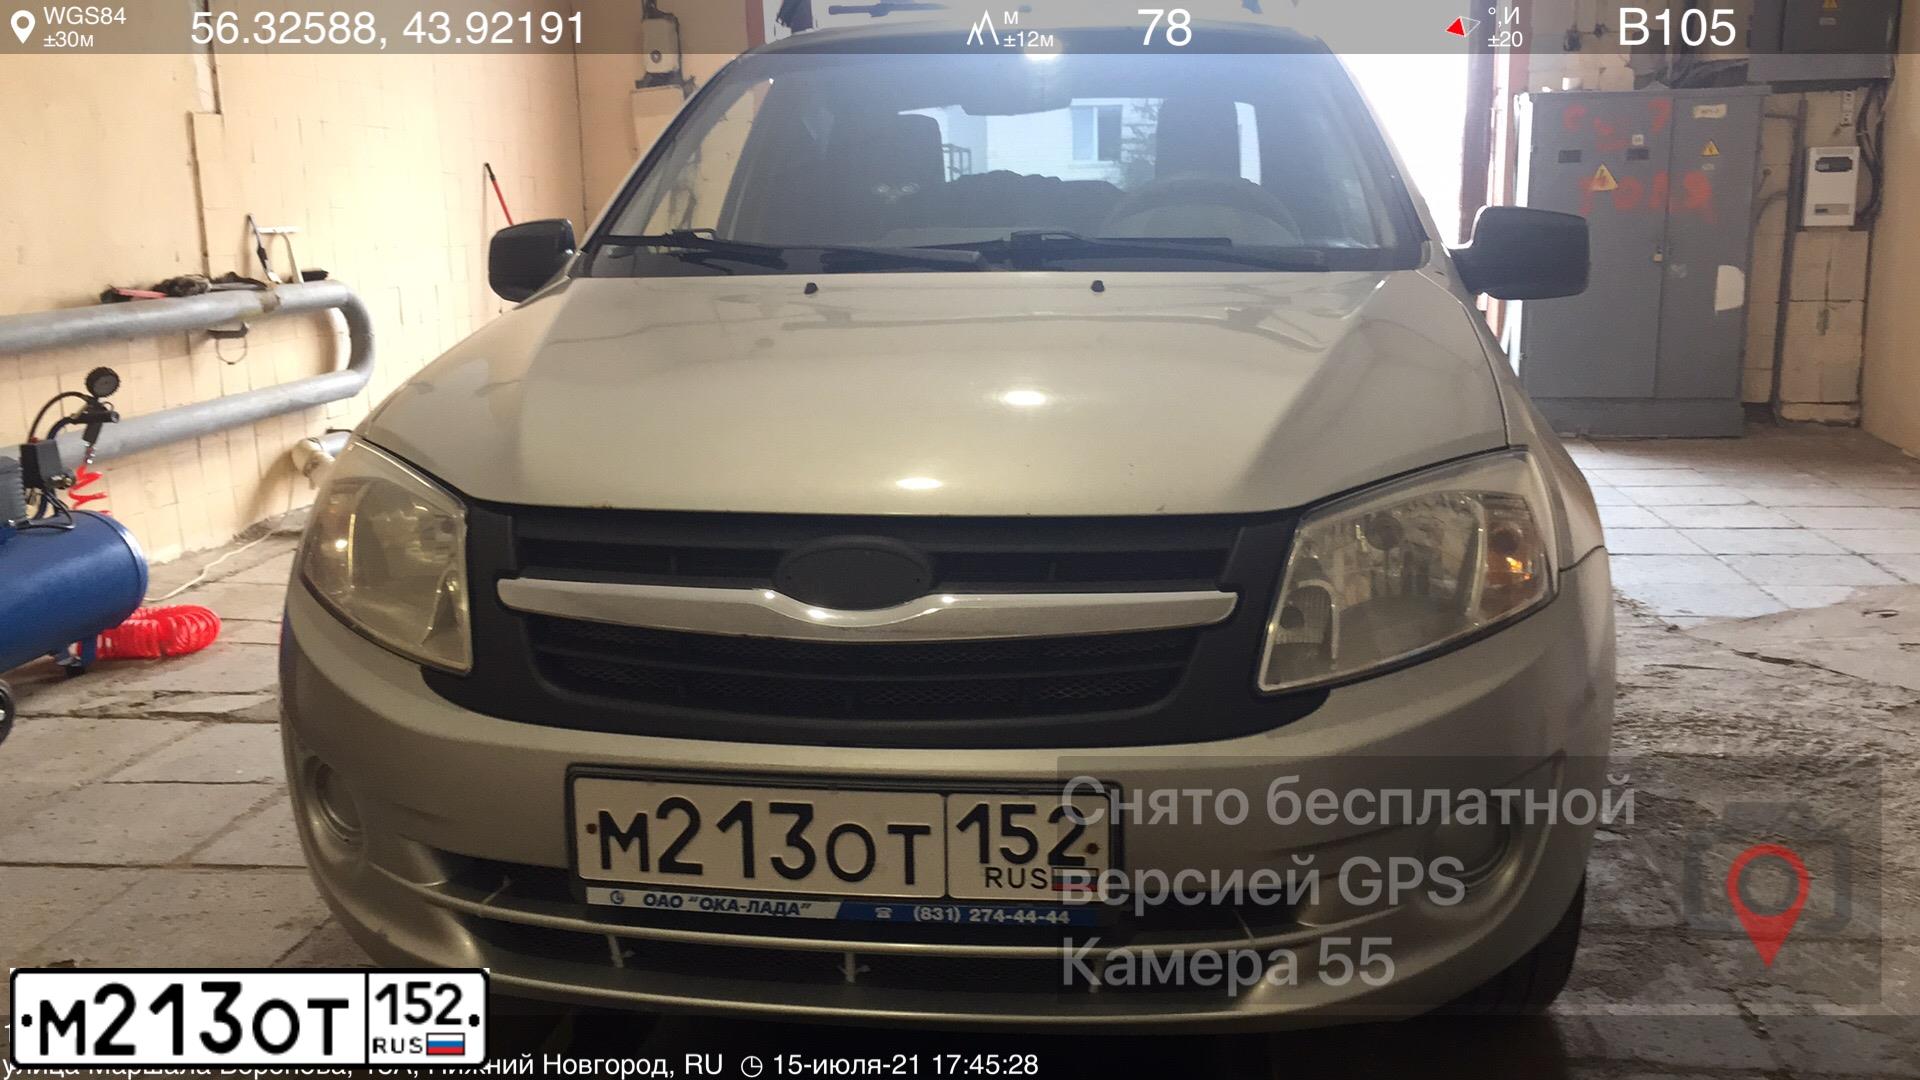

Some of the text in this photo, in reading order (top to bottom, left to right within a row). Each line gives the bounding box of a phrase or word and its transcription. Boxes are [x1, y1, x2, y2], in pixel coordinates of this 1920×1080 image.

[955, 802, 1087, 866] 152
[984, 866, 1049, 891] RUS
[642, 892, 684, 909] ОАО
[912, 904, 1071, 925] (831) 274-44-44
